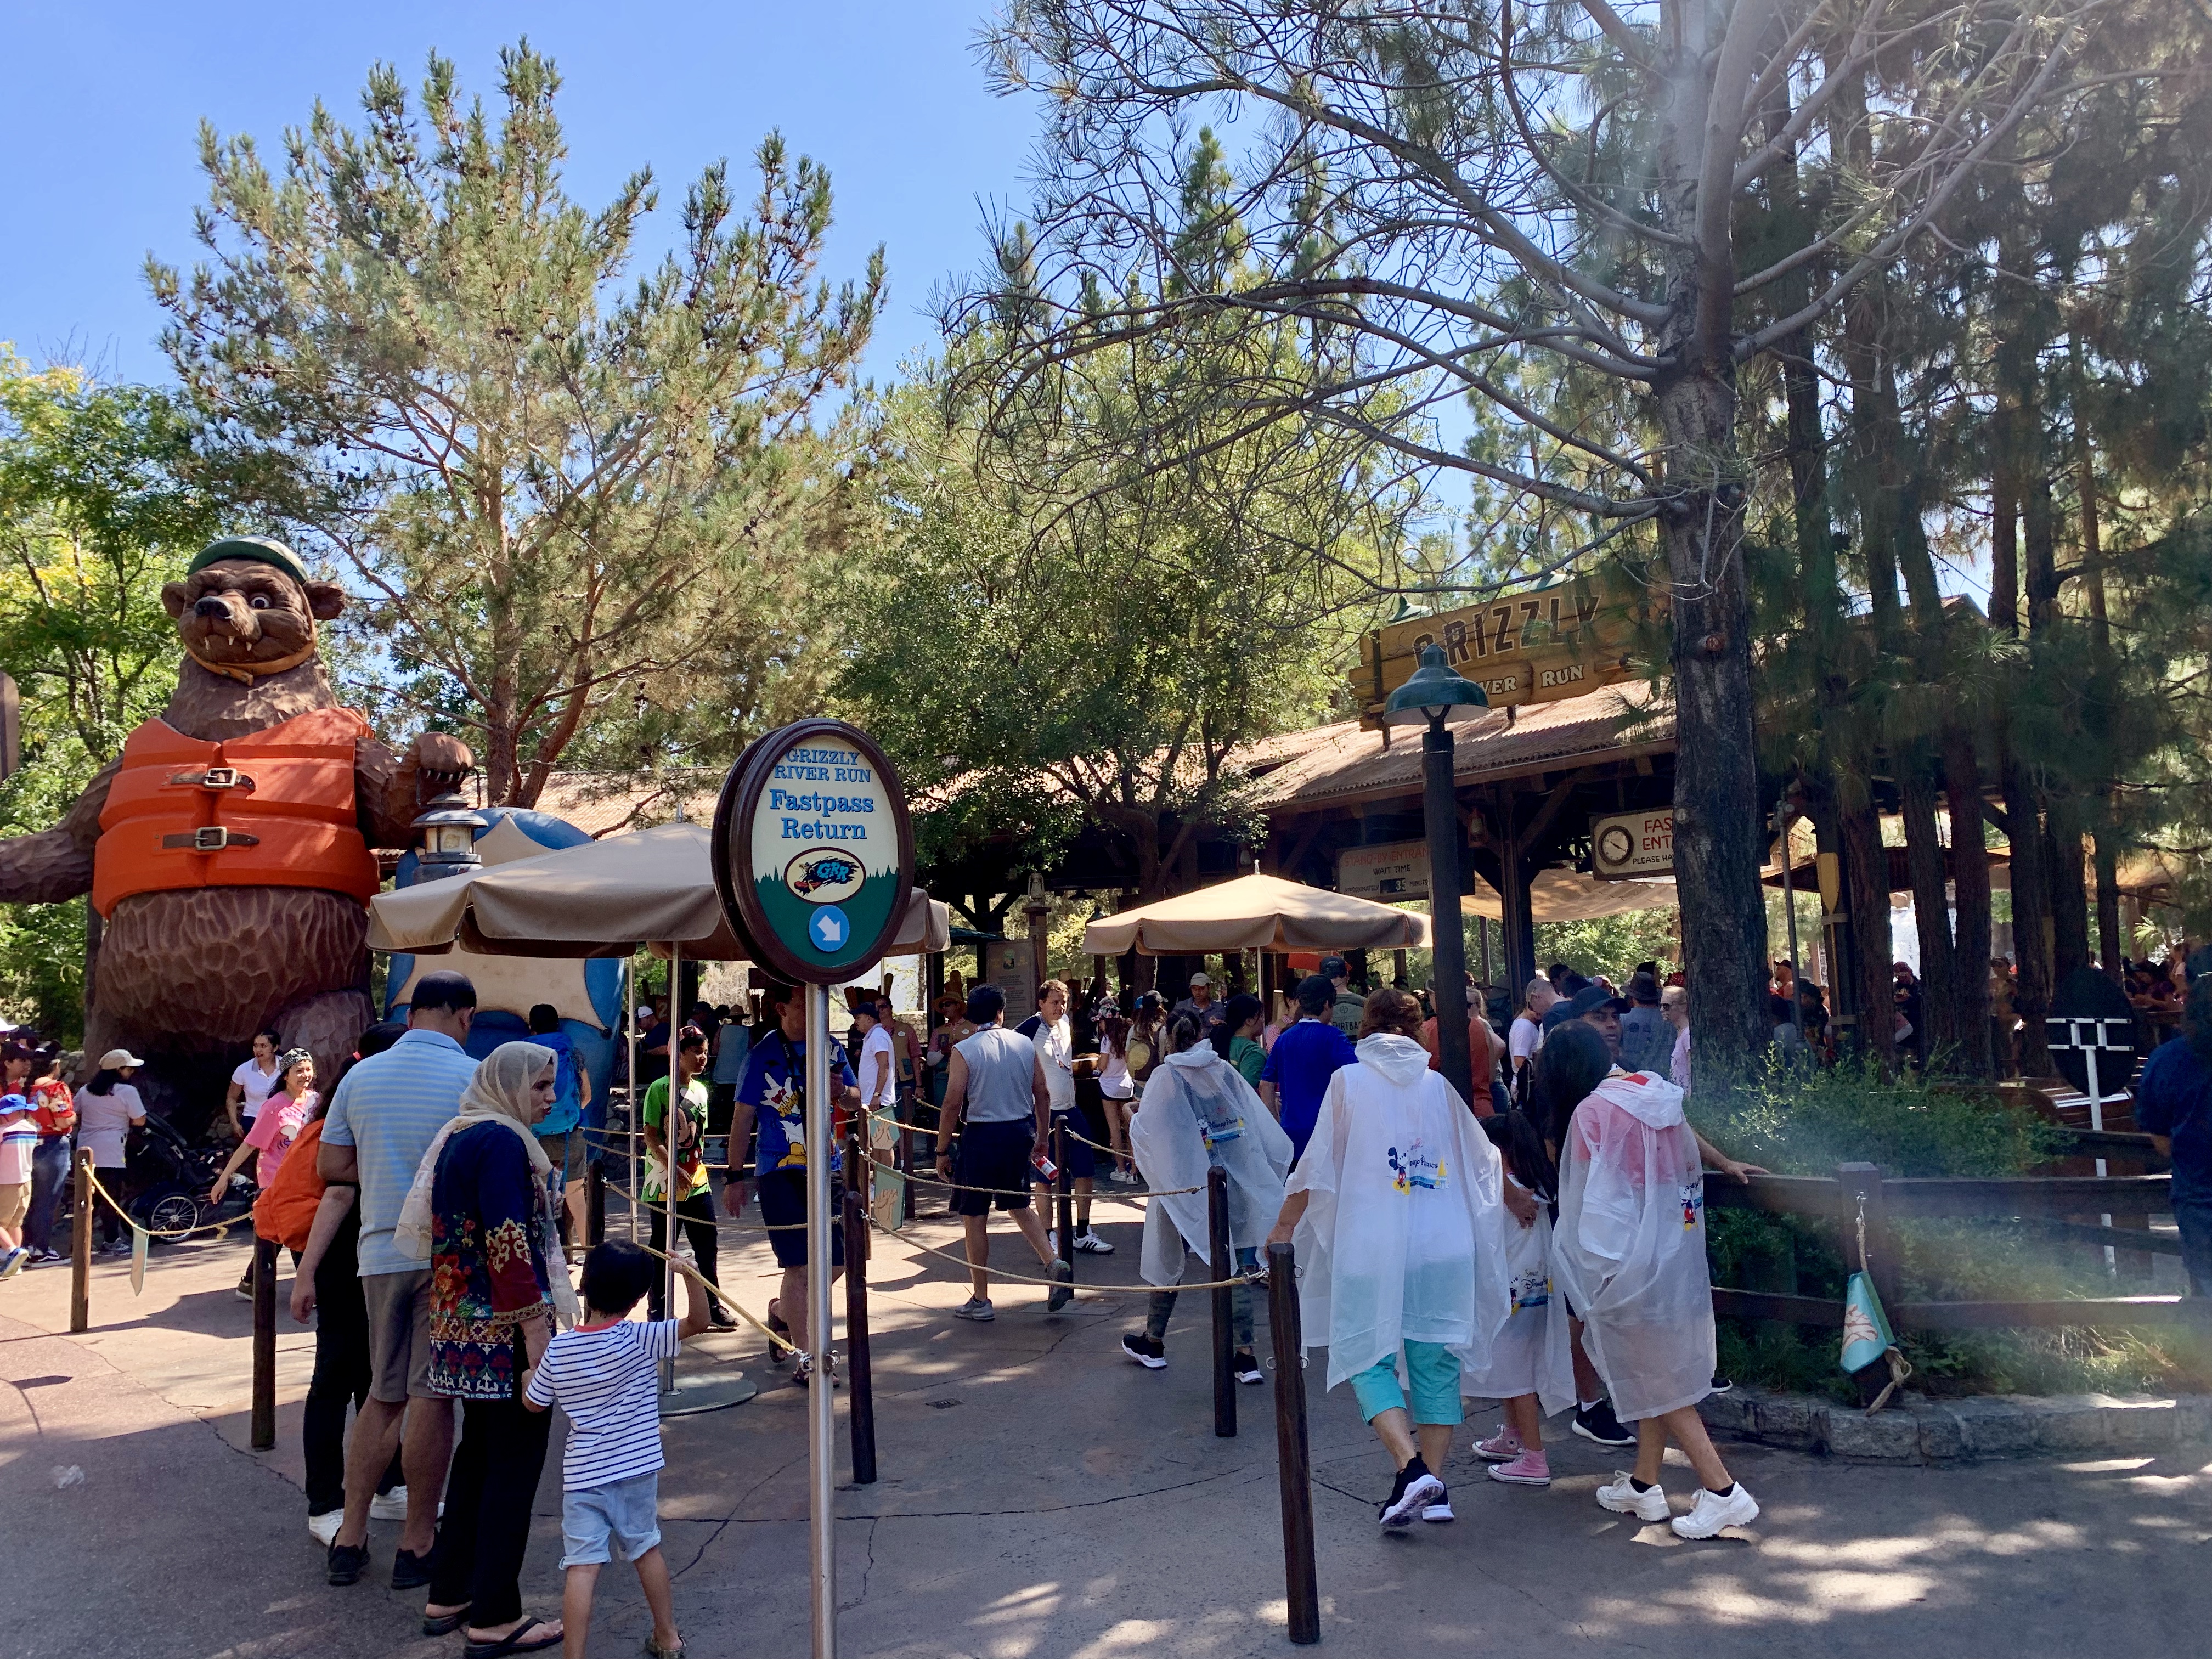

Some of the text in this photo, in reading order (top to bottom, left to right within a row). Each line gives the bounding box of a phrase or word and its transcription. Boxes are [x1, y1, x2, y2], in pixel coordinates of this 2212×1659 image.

[1479, 665, 1584, 694] VER RUN
[786, 749, 860, 765] GRIZZLY
[775, 765, 871, 782] RIVER RUN
[769, 788, 874, 817] Fastpass
[781, 818, 867, 839] Return
[1644, 817, 1673, 833] FAS
[1643, 835, 1672, 851] ENT
[1345, 848, 1429, 866] STAND-BY ENTRAN
[1633, 855, 1660, 865] PLEASE
[817, 862, 849, 882] GRR
[1373, 864, 1410, 876] WAIT TIME
[658, 1002, 668, 1019] 2
